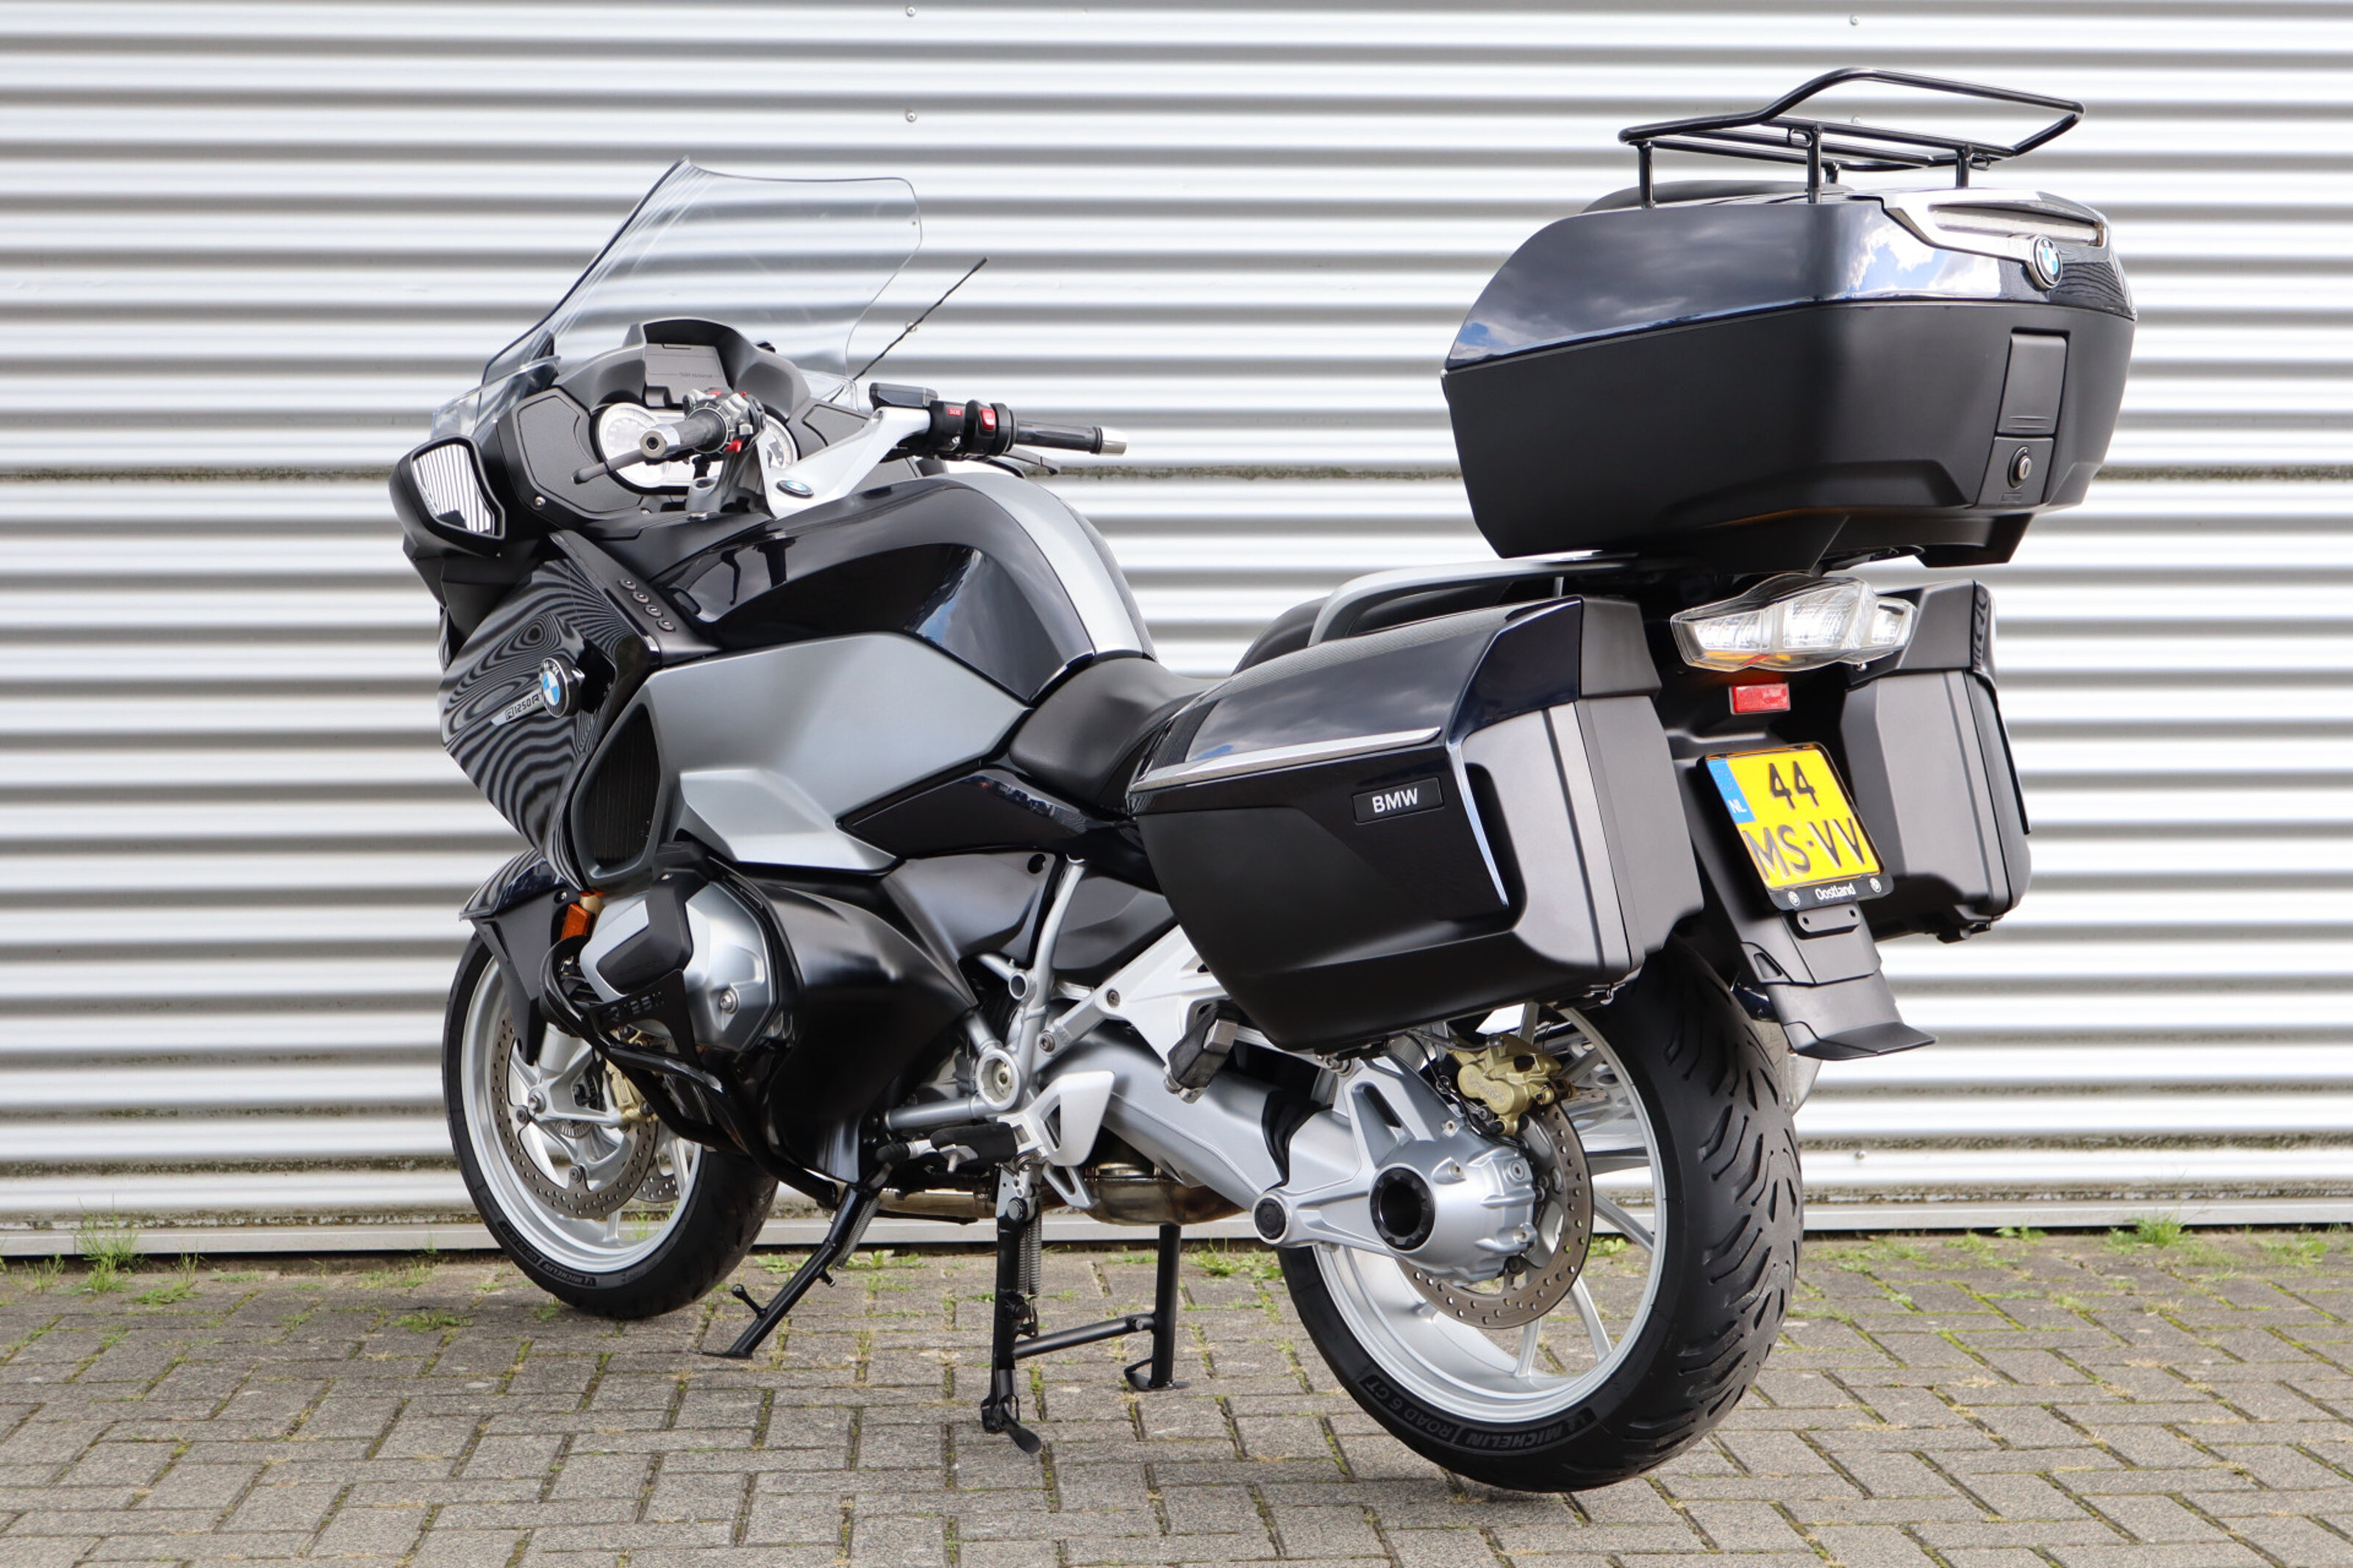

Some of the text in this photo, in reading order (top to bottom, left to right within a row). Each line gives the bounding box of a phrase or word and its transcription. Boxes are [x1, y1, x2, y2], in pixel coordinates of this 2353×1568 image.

[1769, 761, 1820, 810] 44
[1372, 787, 1418, 813] BMW
[1728, 798, 1747, 814] NL
[1815, 882, 1856, 901] Oostland
[543, 1263, 583, 1284] MICHELIN
[1365, 1381, 1564, 1447] MICHELIN ROAD 6 GT
